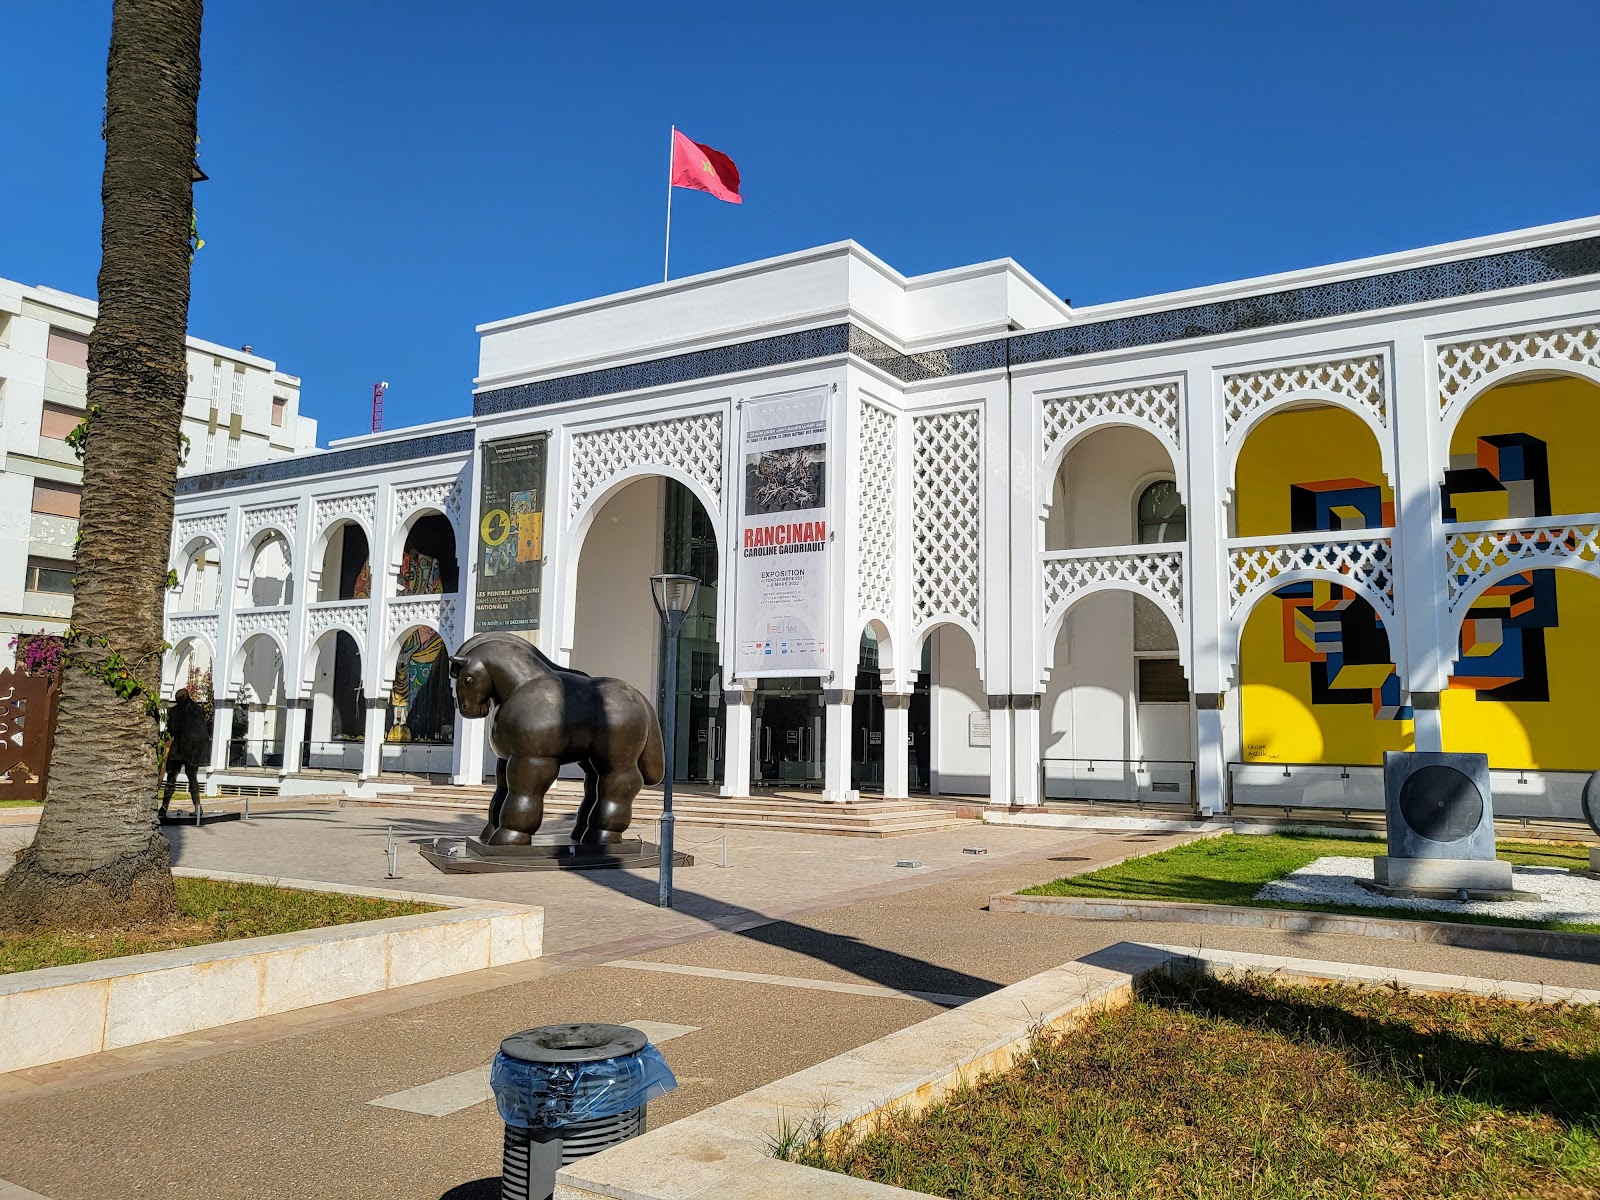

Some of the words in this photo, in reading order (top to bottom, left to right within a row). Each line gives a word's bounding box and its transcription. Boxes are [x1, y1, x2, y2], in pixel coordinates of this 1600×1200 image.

[744, 521, 826, 548] RANCINAN
[744, 546, 778, 558] CAROLINE
[778, 542, 826, 554] GAUDRIAULT
[761, 569, 805, 578] EXPOSITION
